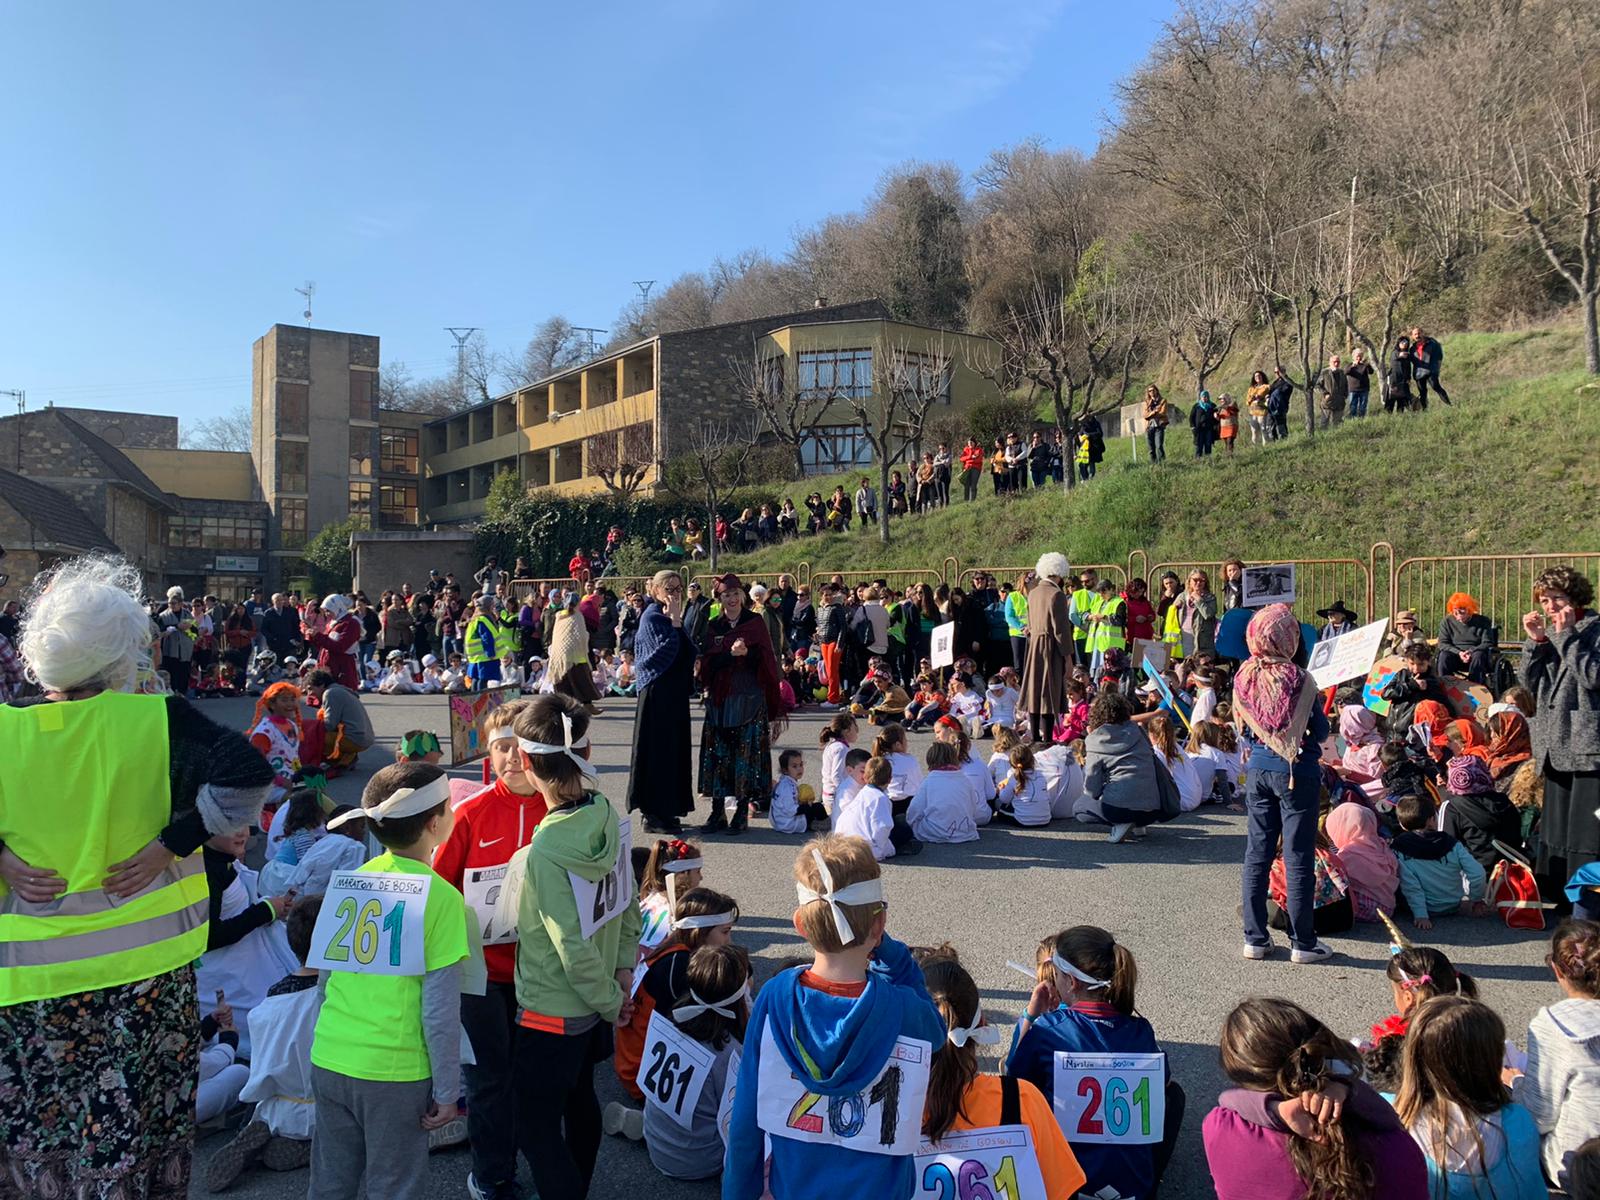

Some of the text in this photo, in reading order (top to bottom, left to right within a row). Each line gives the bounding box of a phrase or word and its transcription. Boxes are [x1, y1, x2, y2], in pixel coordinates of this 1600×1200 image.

[336, 878, 374, 889] MARATON
[379, 880, 391, 890] DE
[324, 896, 407, 967] 261
[643, 1040, 696, 1117] 261
[1077, 1076, 1151, 1137] 261
[923, 1155, 1020, 1200] 261
